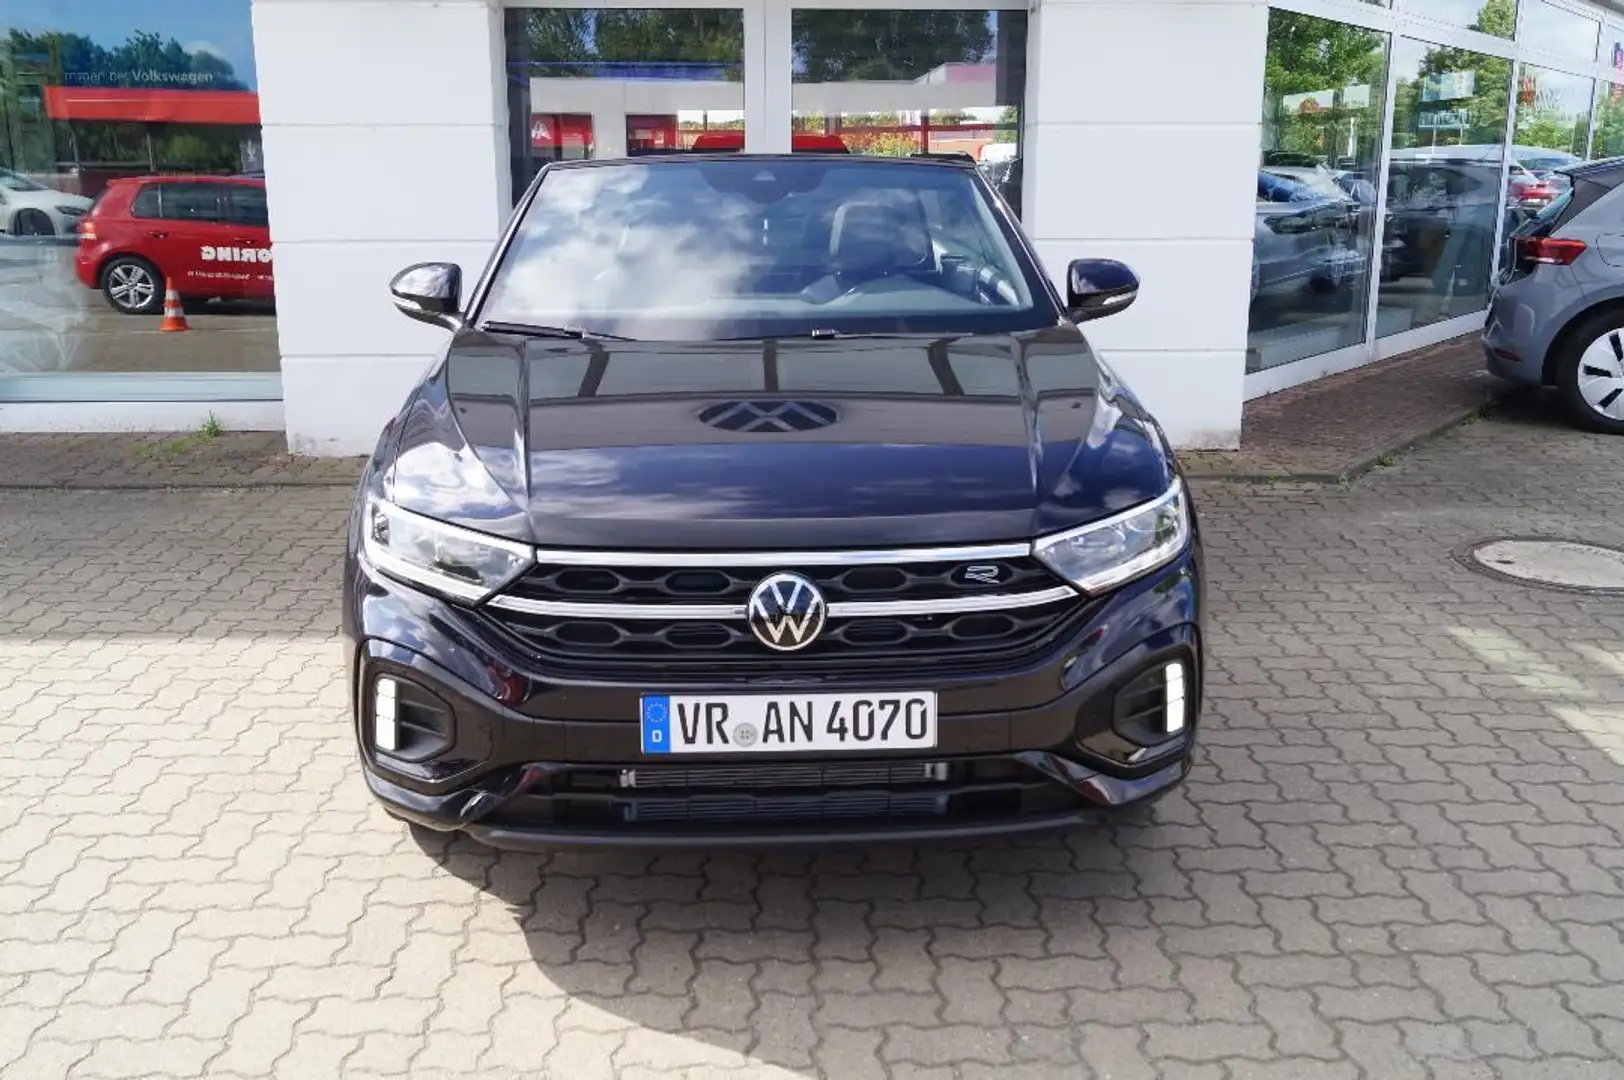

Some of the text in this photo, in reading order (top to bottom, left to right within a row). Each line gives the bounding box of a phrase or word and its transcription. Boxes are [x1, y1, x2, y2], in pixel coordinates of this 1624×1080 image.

[131, 68, 214, 84] Volkswagen
[677, 698, 928, 745] VR AN 4070
[652, 730, 663, 743] D
